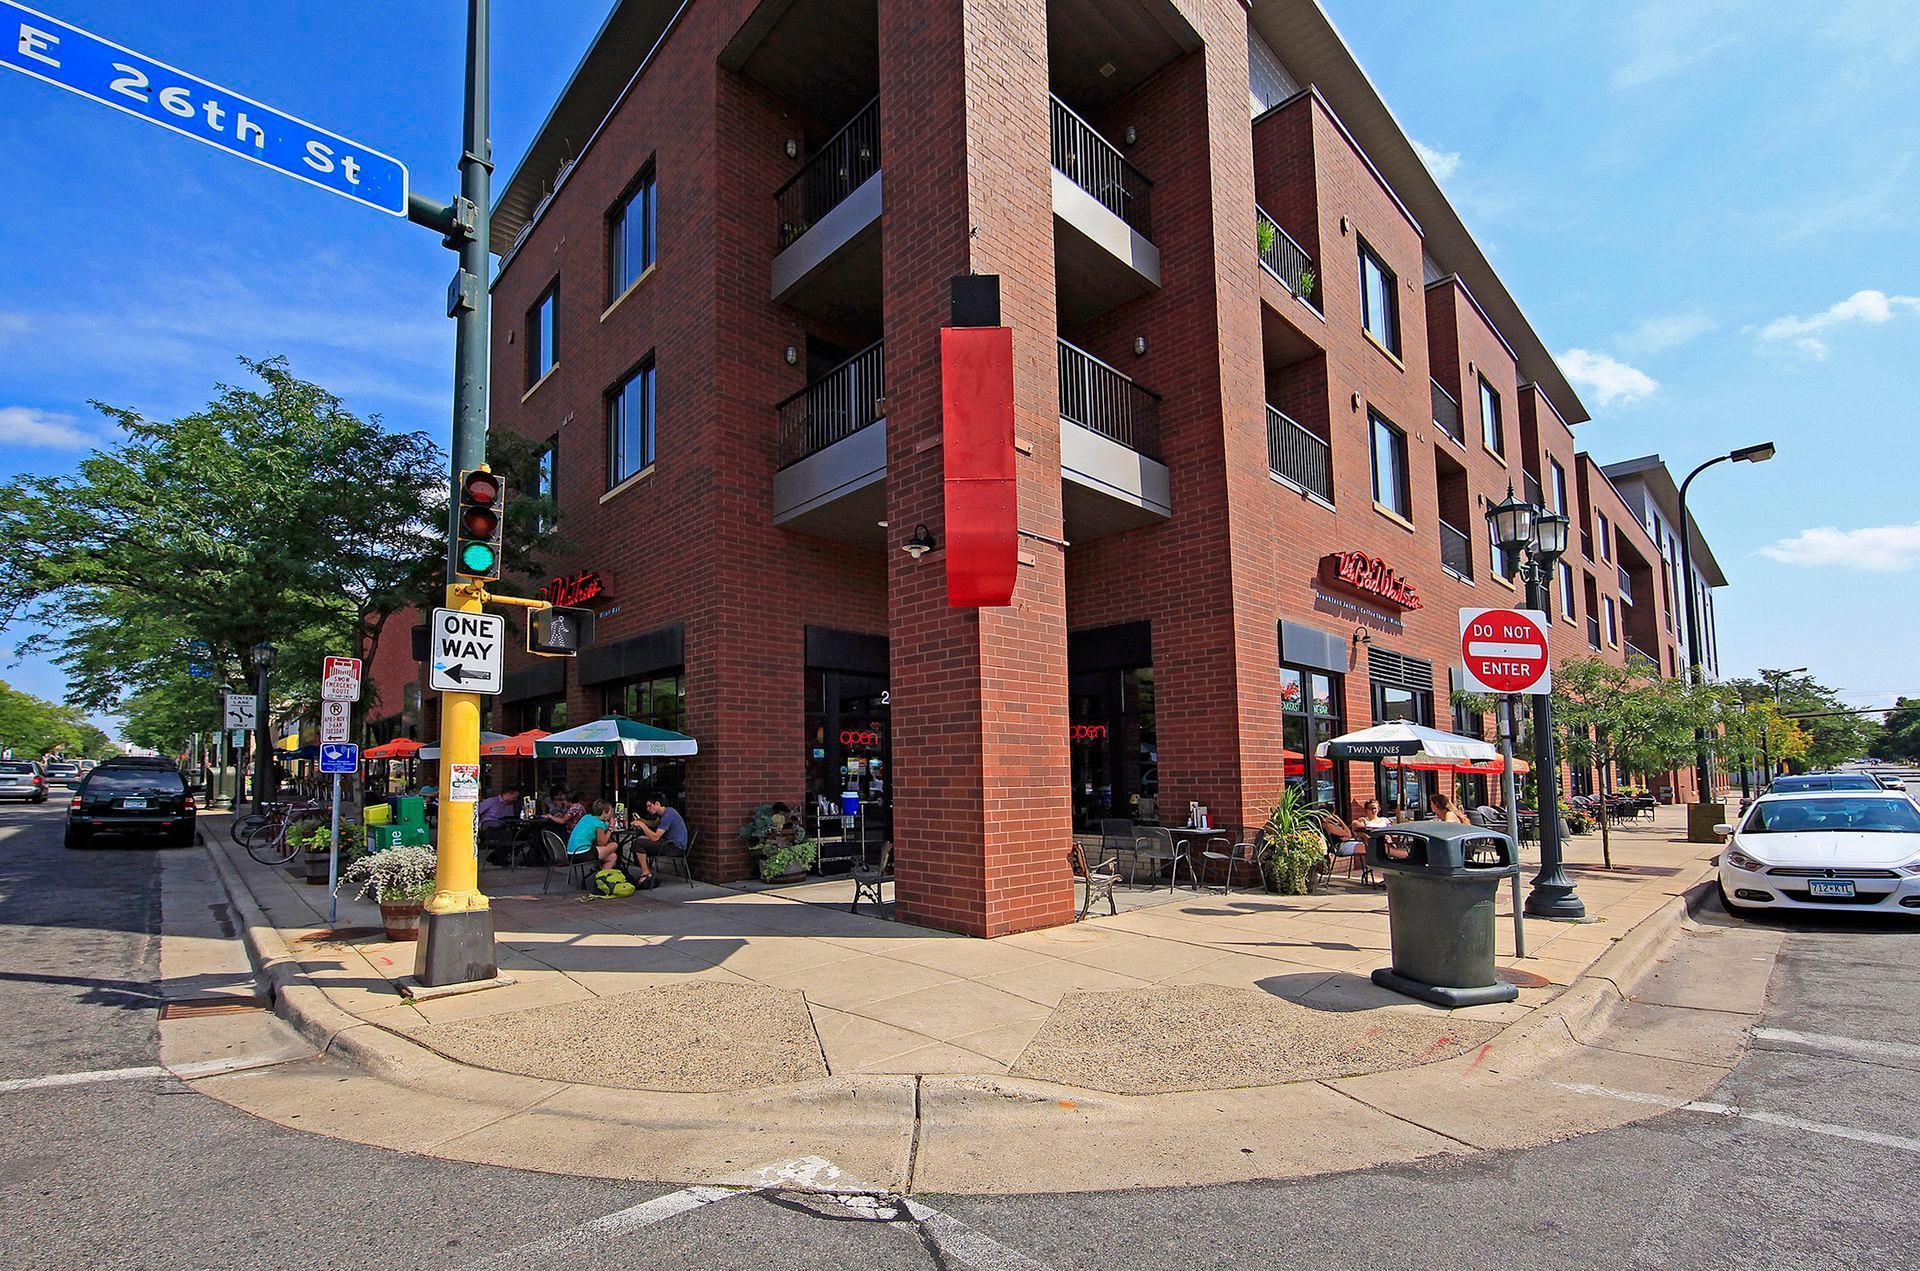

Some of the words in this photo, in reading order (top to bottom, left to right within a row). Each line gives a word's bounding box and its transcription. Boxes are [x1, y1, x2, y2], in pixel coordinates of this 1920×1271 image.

[18, 23, 61, 68] E
[109, 62, 265, 149] 26th
[302, 140, 361, 185] St
[444, 615, 494, 638] ONE
[1473, 624, 1493, 637] DO
[1503, 625, 1531, 639] NOT
[442, 638, 494, 660] WAY
[1482, 661, 1531, 676] ENTER
[325, 681, 357, 689] EMERGENCY
[881, 690, 890, 705] 2
[840, 730, 879, 746] open
[553, 746, 578, 755] TWIN
[579, 746, 605, 755] VINES
[1347, 745, 1374, 754] TWIN
[1373, 745, 1400, 754] VINES
